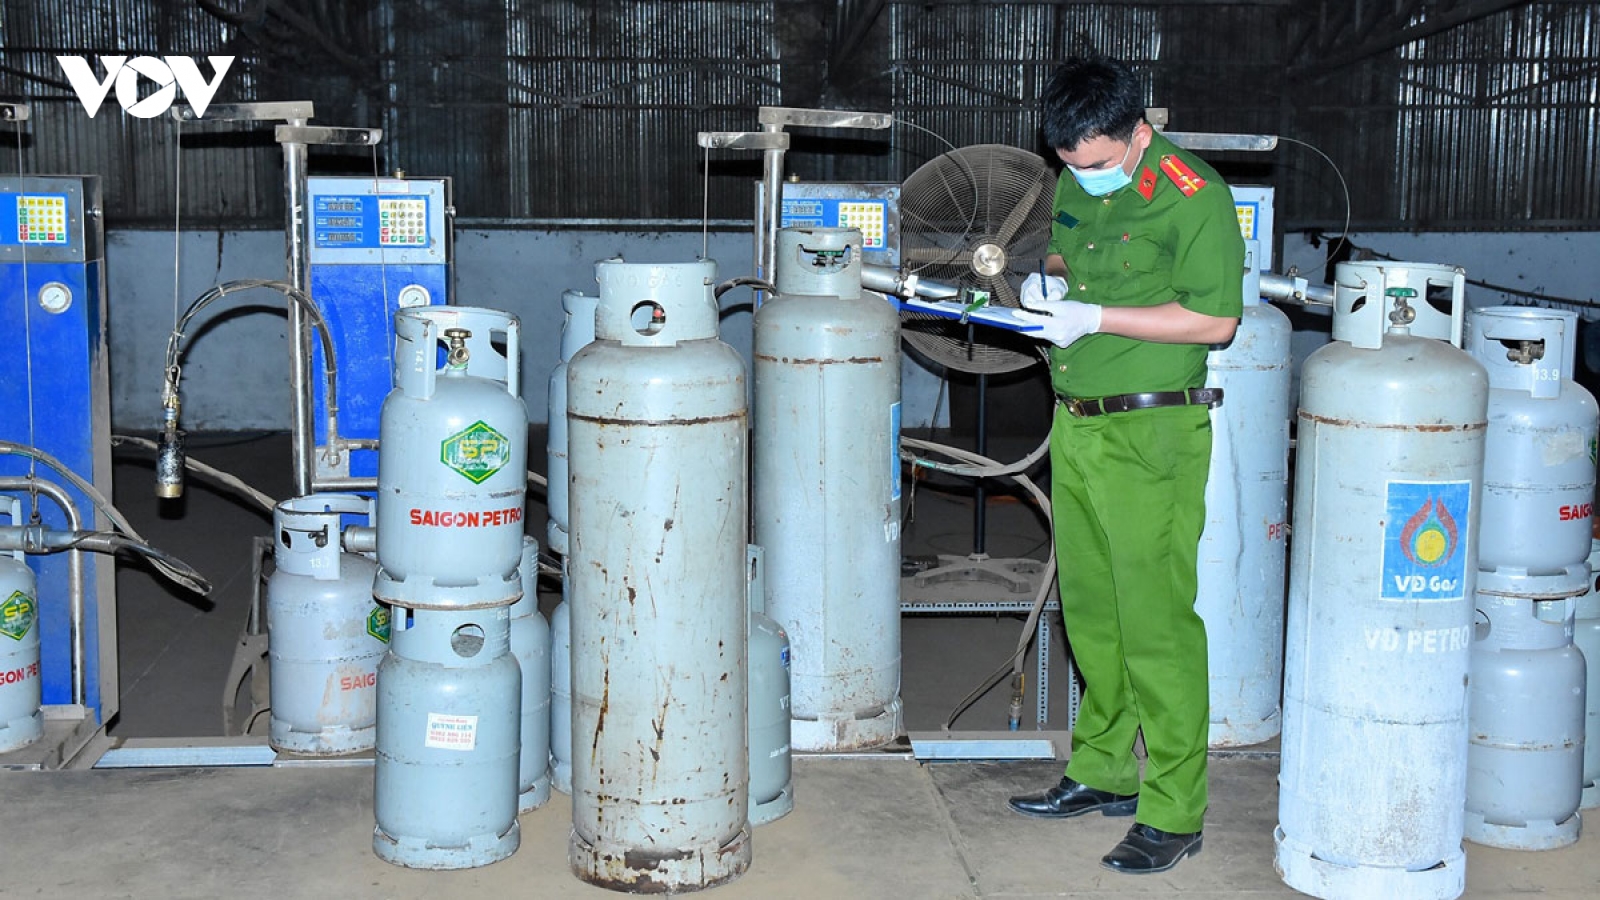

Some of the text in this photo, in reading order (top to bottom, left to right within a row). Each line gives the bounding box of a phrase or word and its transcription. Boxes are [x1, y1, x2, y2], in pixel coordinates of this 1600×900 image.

[410, 507, 522, 527] SAIGON PETRO
[1407, 625, 1470, 653] PETRO
